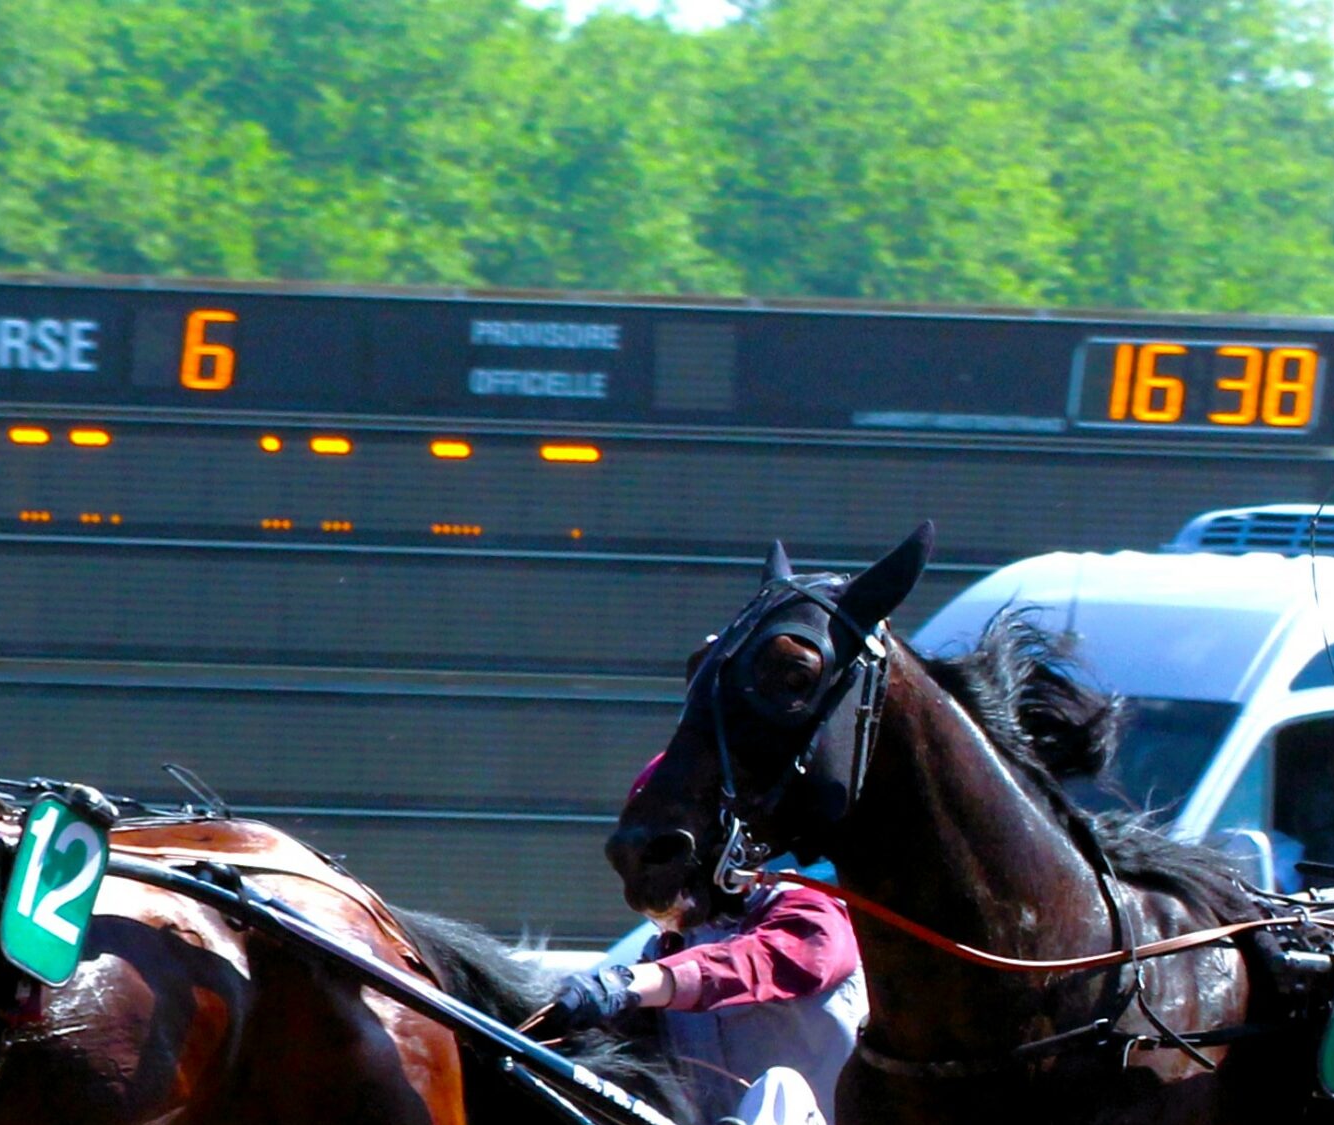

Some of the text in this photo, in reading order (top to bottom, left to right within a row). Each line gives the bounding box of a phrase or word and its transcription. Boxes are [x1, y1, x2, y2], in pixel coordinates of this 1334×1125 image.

[180, 310, 239, 391] 6
[469, 319, 622, 350] PROVISOIRE
[468, 368, 608, 398] OFFICIELLE
[1108, 342, 1319, 428] 16 38
[17, 806, 102, 945] 12
